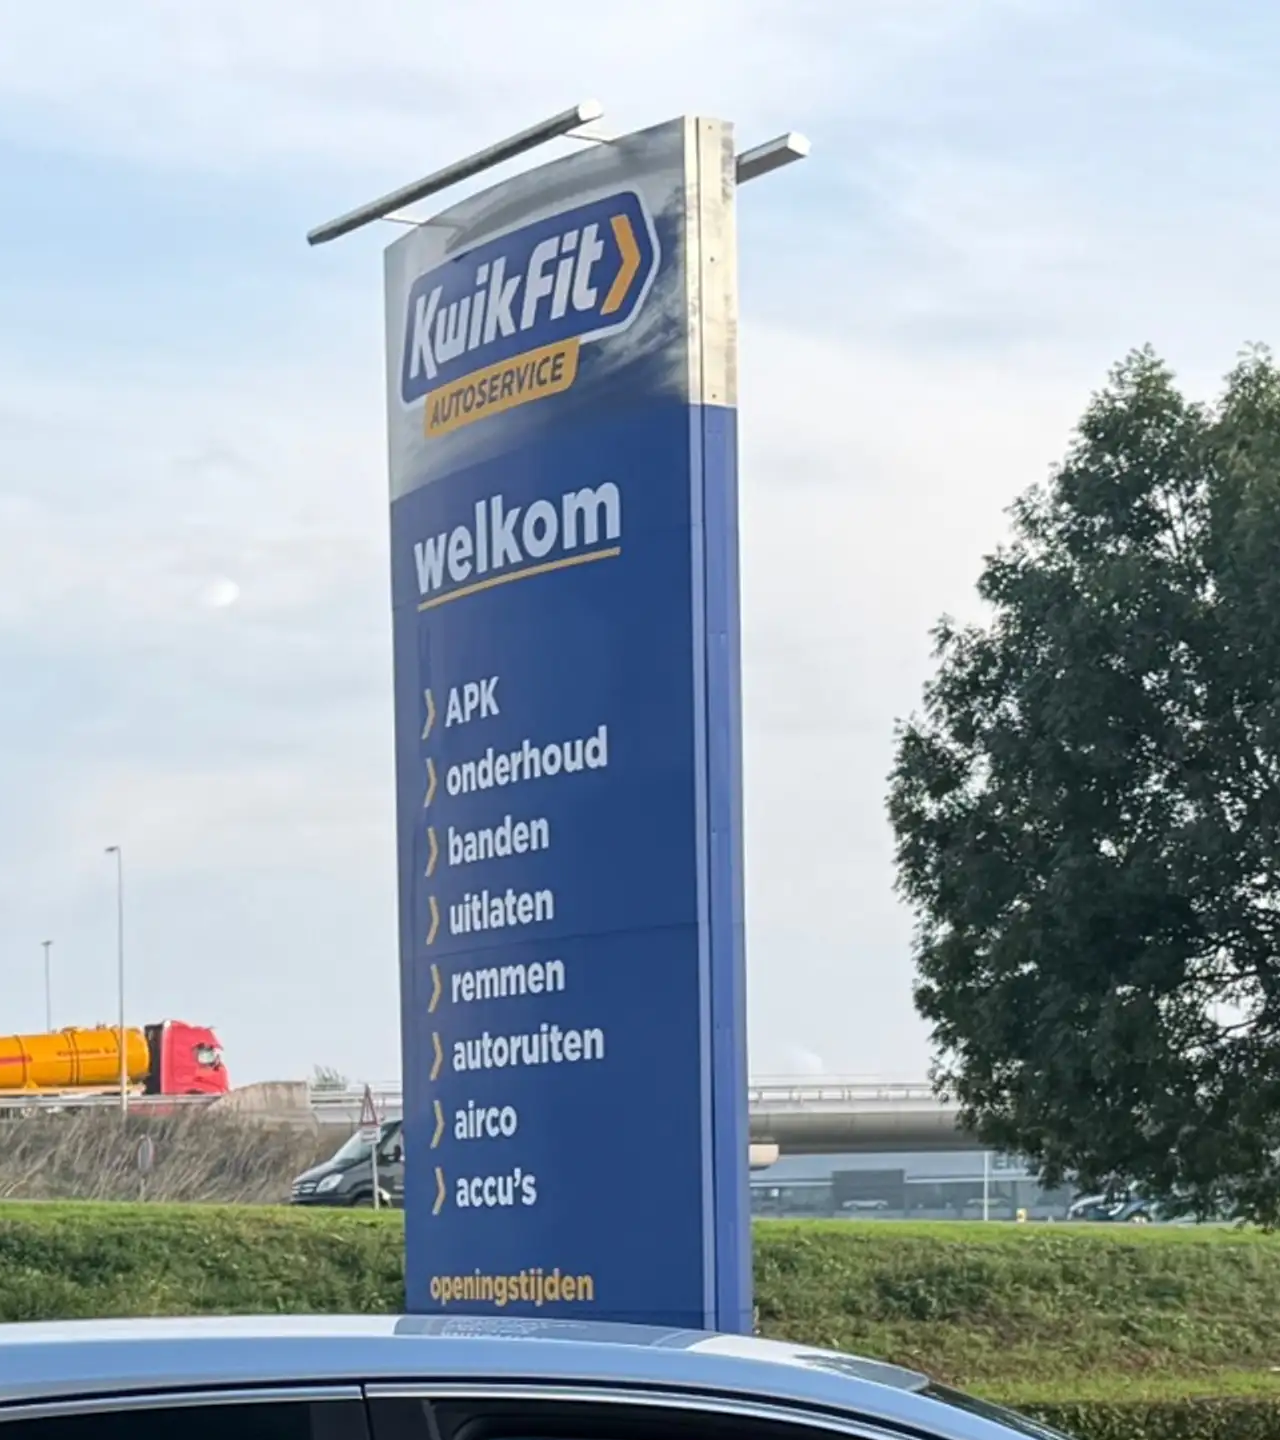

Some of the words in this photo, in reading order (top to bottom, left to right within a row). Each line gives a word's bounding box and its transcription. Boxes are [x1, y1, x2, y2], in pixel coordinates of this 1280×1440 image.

[429, 352, 566, 430] AUTOSERVICE
[414, 481, 621, 595] welkom
[445, 676, 500, 728] APK
[445, 725, 608, 796] onderhoud
[447, 814, 549, 866] banden
[449, 887, 554, 935] uitlaten
[451, 959, 565, 1003] remmen
[452, 1023, 605, 1072] autoruiten
[454, 1099, 518, 1140] airco
[455, 1167, 537, 1208] accu's
[429, 1267, 594, 1308] openingstijden
